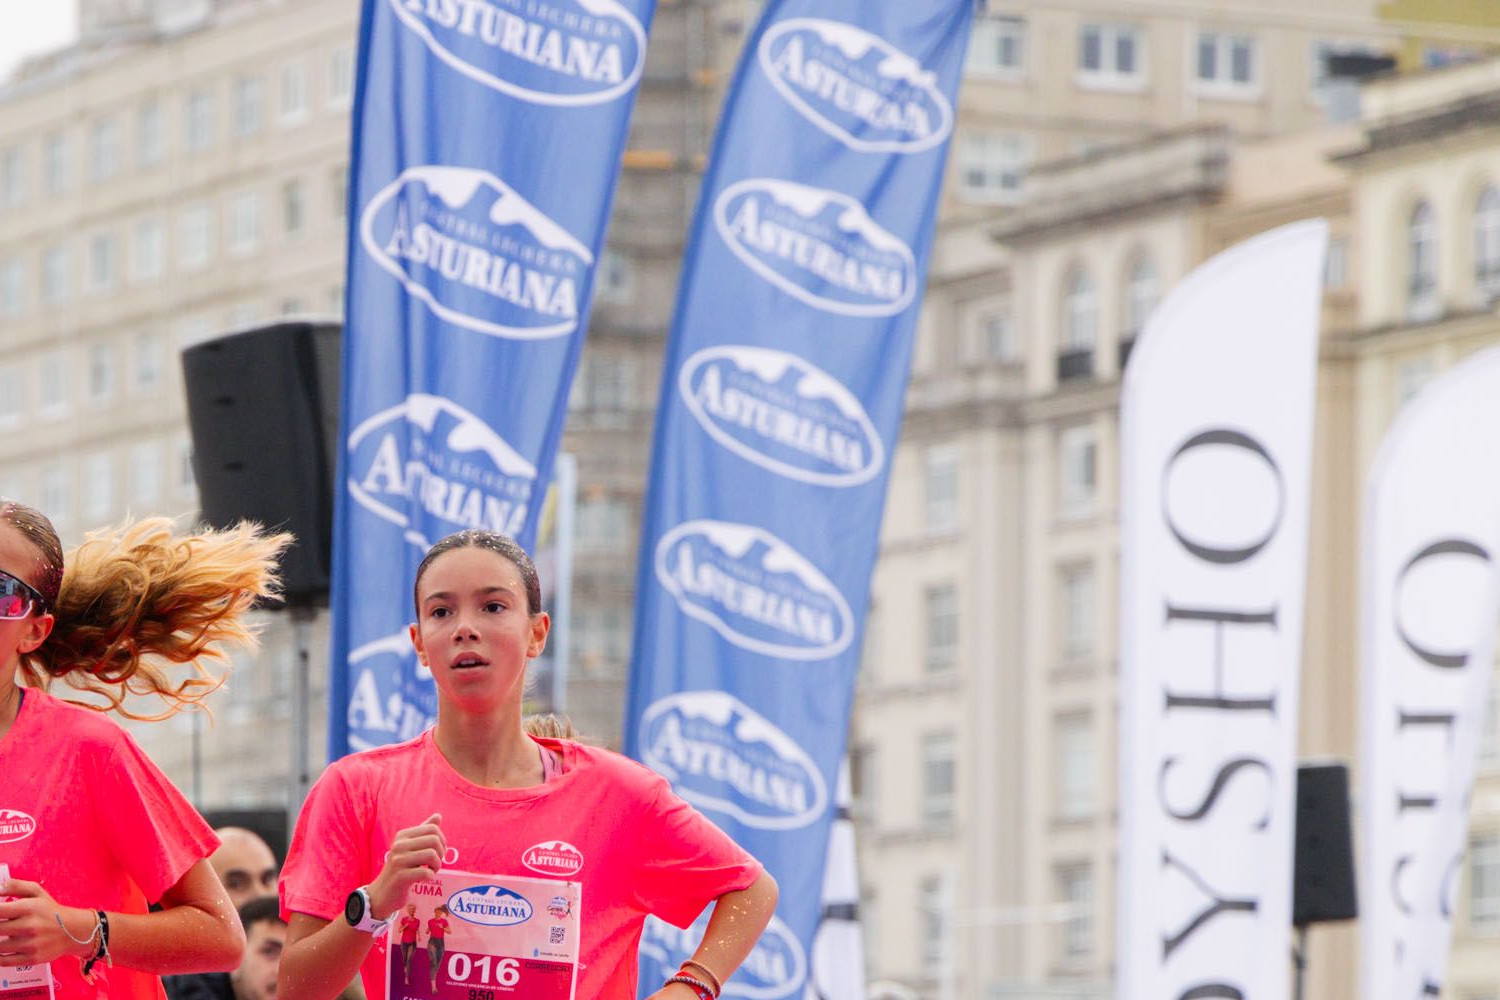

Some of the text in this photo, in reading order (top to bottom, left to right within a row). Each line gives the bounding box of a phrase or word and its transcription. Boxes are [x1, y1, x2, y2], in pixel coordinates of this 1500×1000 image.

[383, 198, 578, 318] ASTURIANA
[527, 851, 579, 869] ASTURIANA
[411, 884, 444, 897] UMA
[453, 896, 527, 919] ASTURIANA
[447, 952, 521, 987] 016
